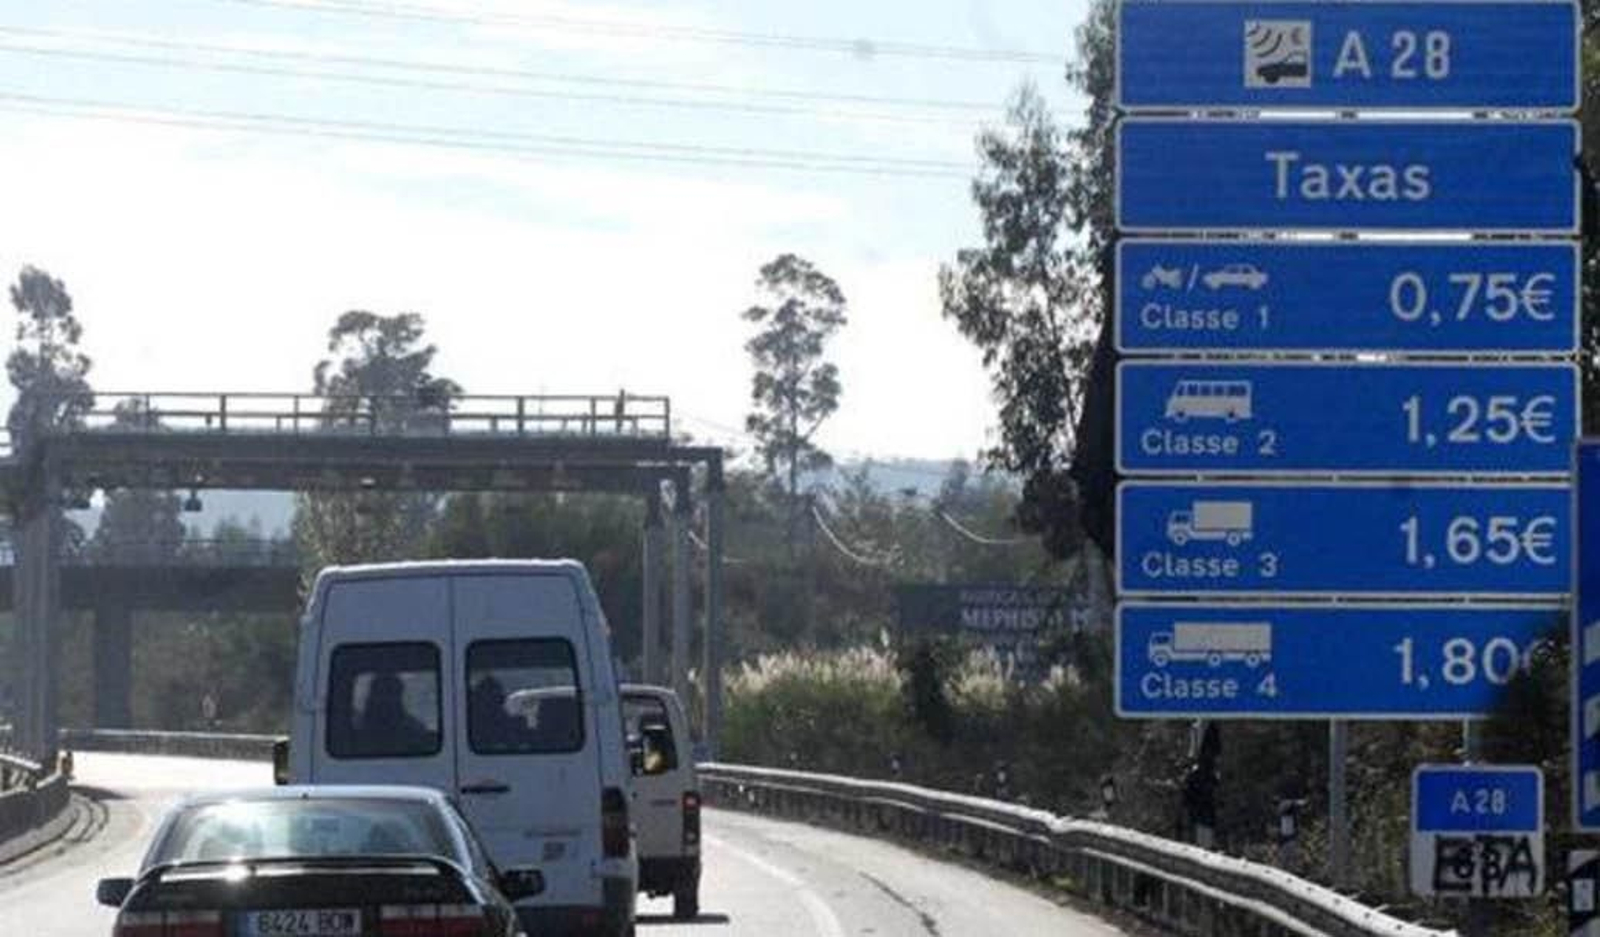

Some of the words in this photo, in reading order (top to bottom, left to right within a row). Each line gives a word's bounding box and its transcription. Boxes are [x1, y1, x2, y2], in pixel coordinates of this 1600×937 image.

[1333, 30, 1371, 79] A
[1391, 30, 1451, 79] 28
[1265, 151, 1431, 201] Taxas
[1140, 303, 1239, 330] Classe
[1259, 305, 1269, 328] 1
[1389, 271, 1556, 326] 0,75€
[1402, 395, 1556, 449] 1,25€
[1140, 428, 1239, 455] Classe
[1259, 430, 1277, 455] 2
[1400, 516, 1557, 569] 1,65€
[1140, 552, 1239, 578] Classe
[1260, 553, 1278, 578] 3
[1140, 673, 1239, 699] Classe
[1257, 673, 1278, 699] 4
[1450, 790, 1471, 814] A
[1475, 788, 1506, 815] 28
